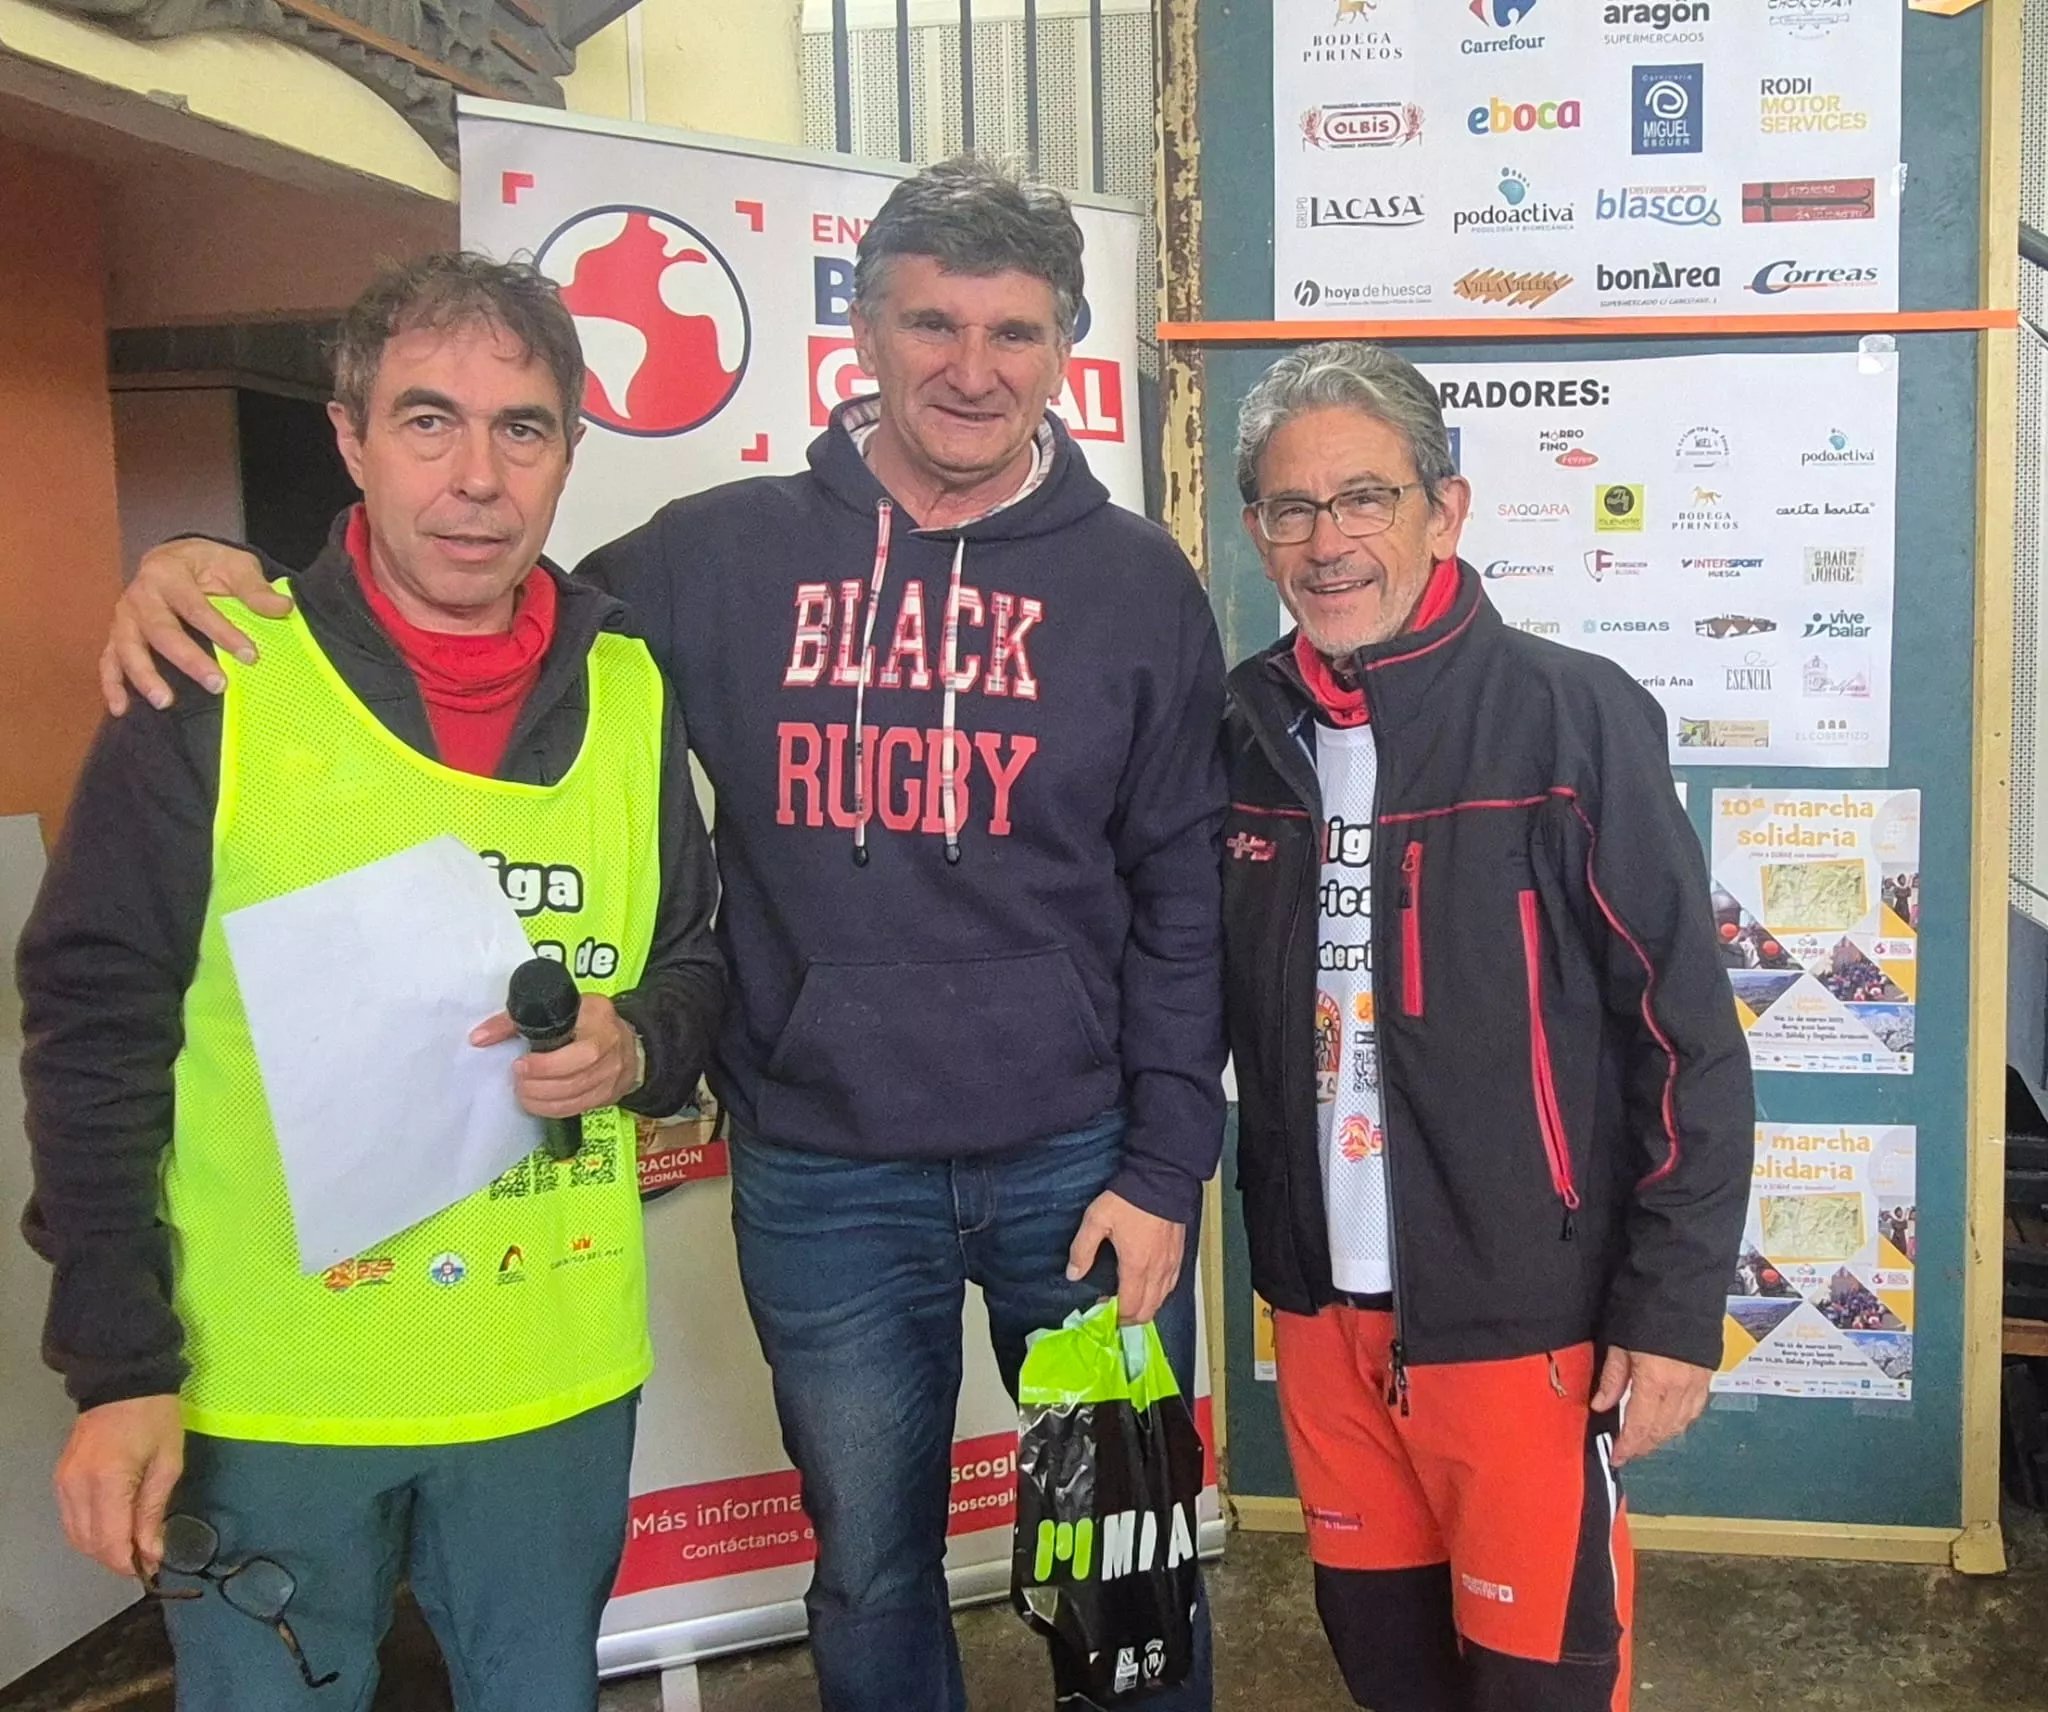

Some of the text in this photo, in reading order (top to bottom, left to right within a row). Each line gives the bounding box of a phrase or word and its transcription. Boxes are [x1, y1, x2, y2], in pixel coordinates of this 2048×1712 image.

[1313, 32, 1392, 46] BODEGA
[1461, 34, 1546, 54] Carrefour
[1603, 32, 1705, 44] SUPERMERCADOS
[1303, 48, 1403, 62] PIRINEOS
[1761, 78, 1812, 95] RODI
[1761, 96, 1841, 115] MOTOR
[1467, 97, 1580, 135] eboca
[1761, 112, 1867, 133] SERVICES
[1643, 119, 1691, 138] MIGUEL
[1310, 196, 1426, 228] LACASA
[1596, 187, 1712, 224] blasco
[1453, 203, 1574, 234] podoactiva
[1597, 261, 1721, 291] bonArea
[1752, 260, 1879, 294] Correas
[1325, 284, 1432, 300] hoya de huesca
[1440, 379, 1610, 408] RADORES:
[1540, 442, 1568, 451] FINO
[1802, 450, 1874, 466] podoactiva
[1498, 503, 1570, 516] SAQQARA
[1679, 511, 1732, 520] BODEGA
[1672, 521, 1739, 530] PIRINEOS
[1484, 560, 1555, 579] Correas
[1694, 558, 1763, 568] INTERSPORT
[1600, 621, 1670, 631] CASBAS
[1830, 610, 1865, 623] vive
[782, 579, 1044, 700] BLACK
[1829, 624, 1872, 637] balar
[1670, 676, 1694, 686] Ana
[1726, 669, 1772, 690] ESENCIA
[776, 721, 1038, 836] RUGBY
[1773, 794, 1875, 818] marcha
[1738, 823, 1857, 847] solidaria
[575, 936, 619, 979] de
[1772, 1128, 1872, 1153] marcha
[637, 1149, 703, 1173] RACIÓN
[1753, 1155, 1854, 1181] olidaria
[638, 1169, 687, 1187] CIONAL
[632, 1510, 687, 1540] Más
[697, 1493, 802, 1527] informa
[682, 1529, 799, 1560] Contáctanos
